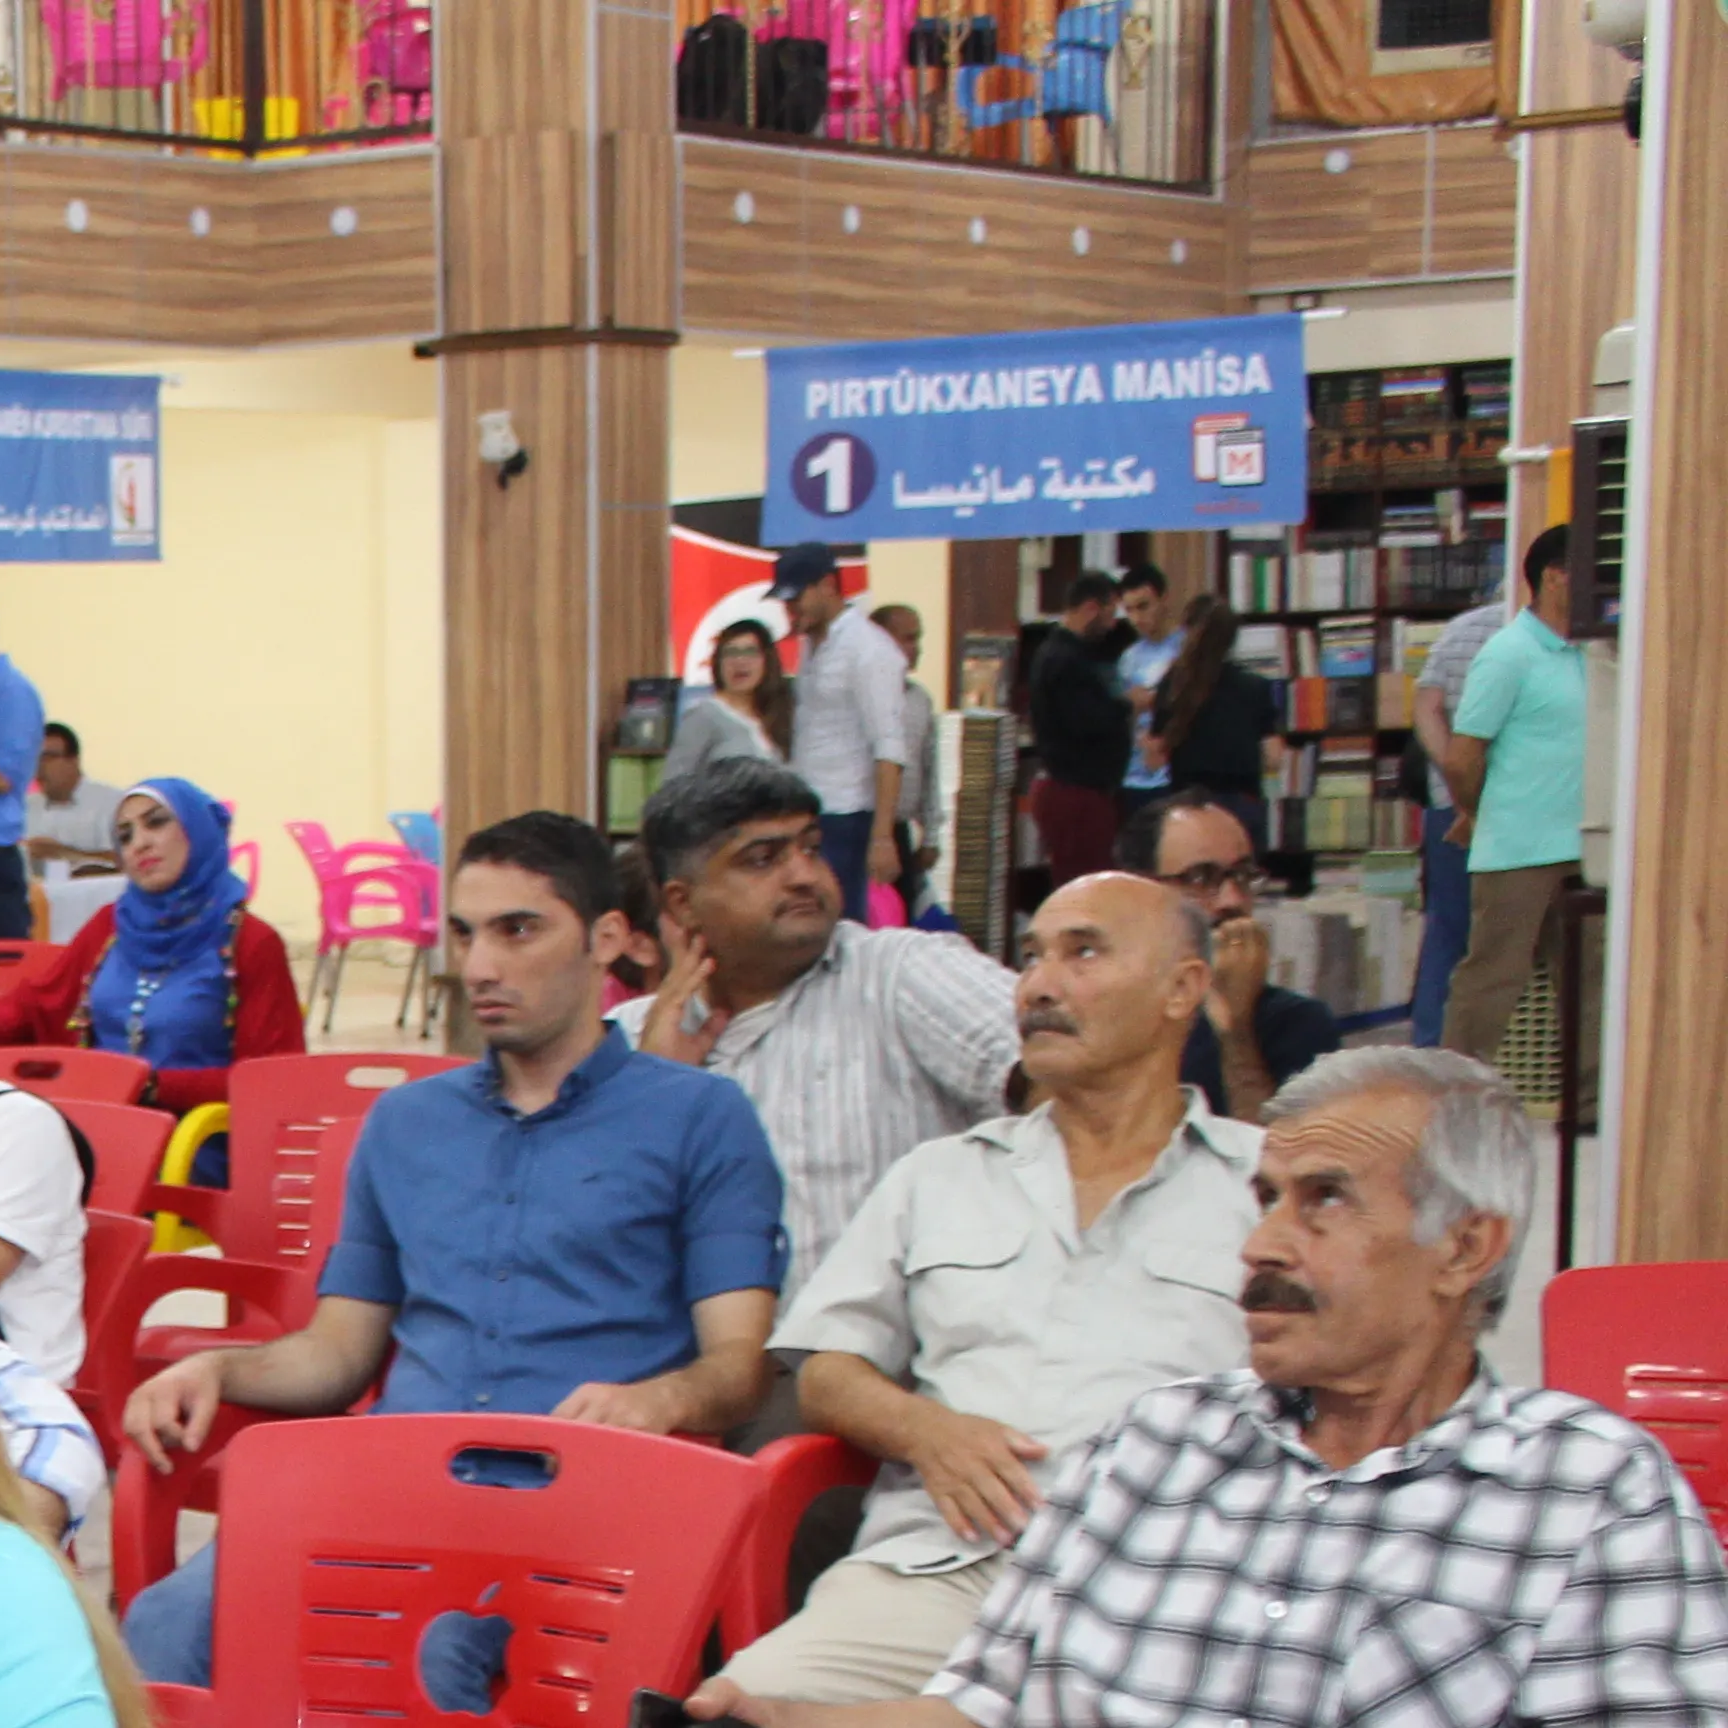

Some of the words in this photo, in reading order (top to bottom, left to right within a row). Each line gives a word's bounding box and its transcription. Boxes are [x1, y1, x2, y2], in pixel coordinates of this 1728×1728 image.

[805, 366, 1104, 420] PIRTÛKXANEYA
[805, 437, 854, 514] 1
[892, 464, 1034, 518] مانيسا
[1040, 455, 1157, 512] مكتبة
